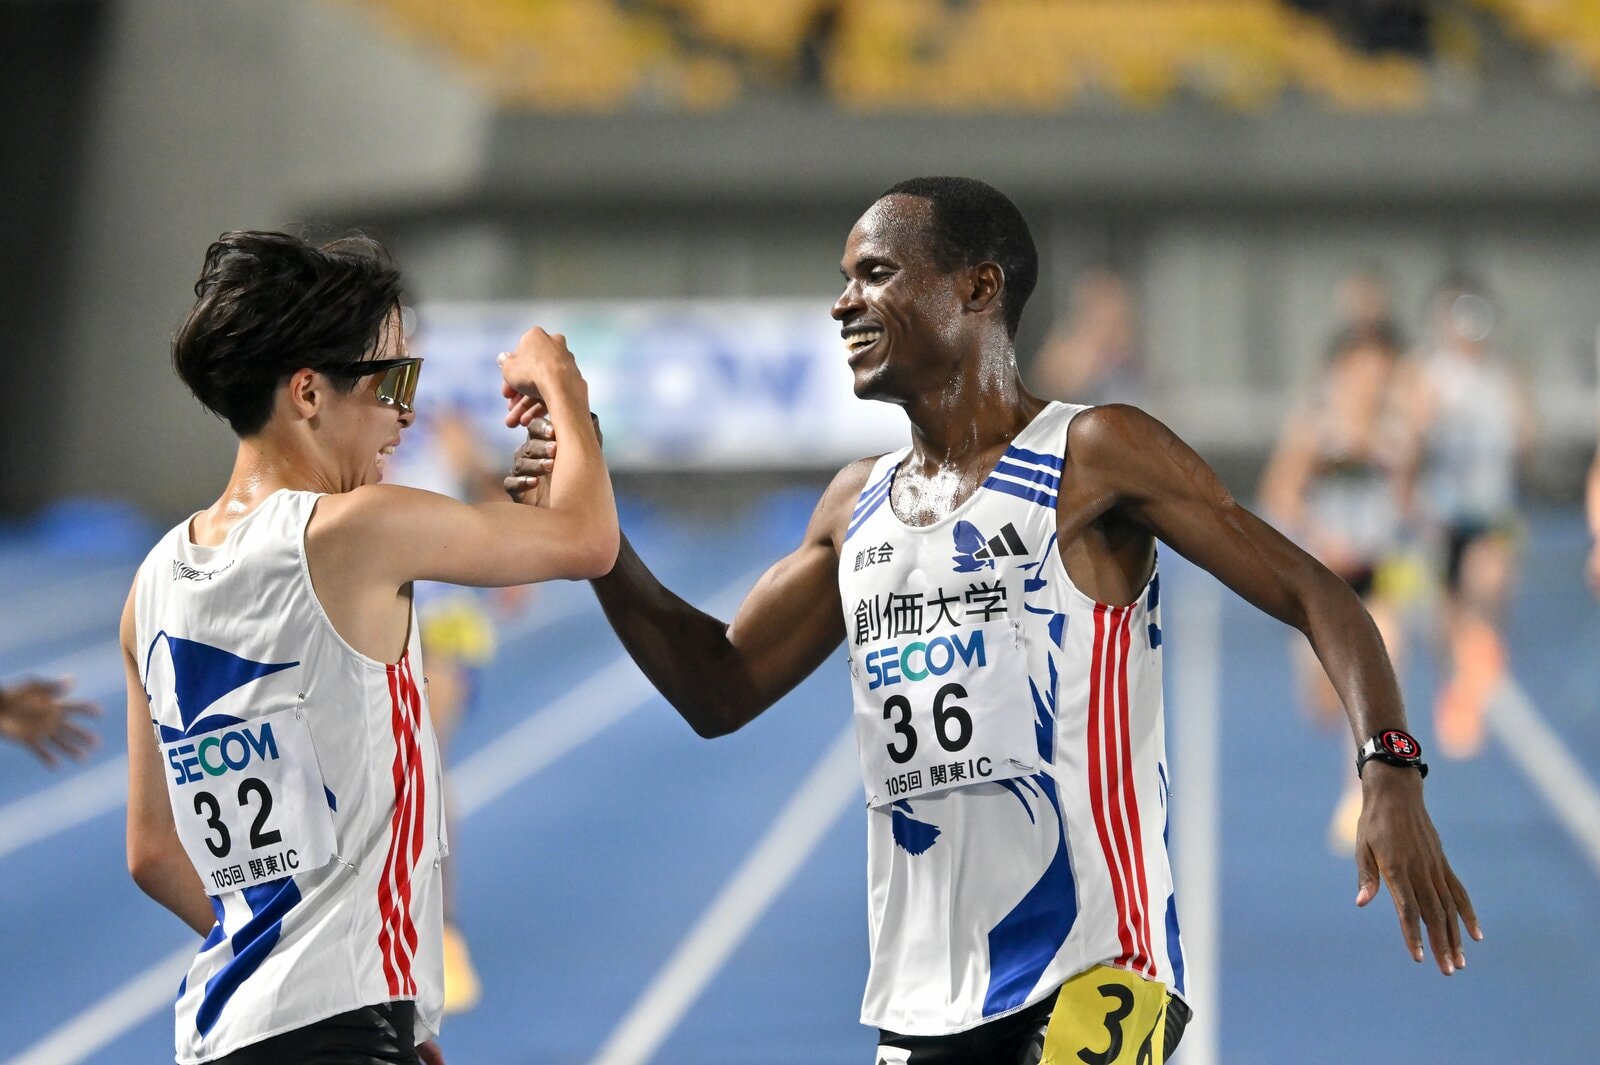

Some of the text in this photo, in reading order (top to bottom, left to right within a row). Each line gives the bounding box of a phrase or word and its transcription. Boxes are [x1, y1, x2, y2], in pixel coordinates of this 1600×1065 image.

[853, 541, 894, 572] 創友会
[854, 580, 1008, 646] 創価大学
[865, 629, 987, 690] SECOM
[168, 722, 280, 786] SECOM
[882, 682, 973, 764] 36
[885, 756, 993, 797] 105回 関東IC
[193, 777, 282, 859] 32
[211, 849, 300, 889] 105回 関東IC
